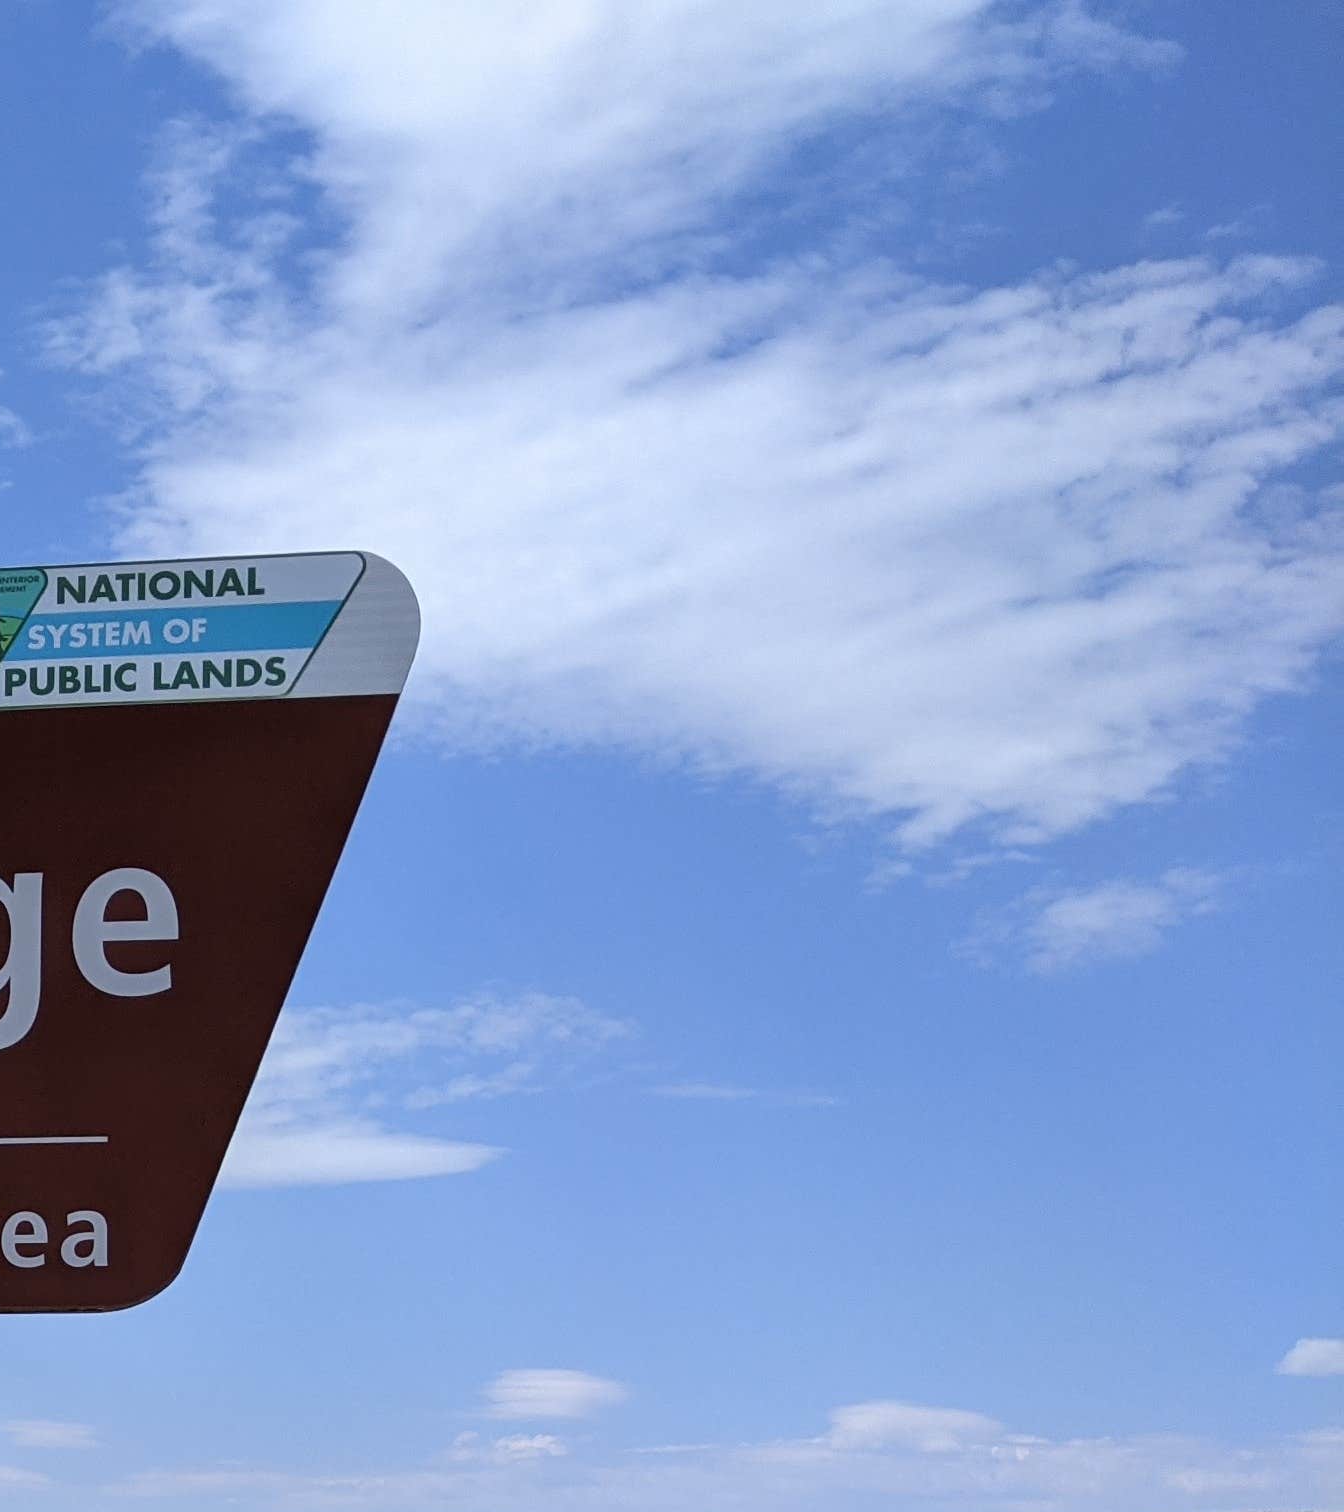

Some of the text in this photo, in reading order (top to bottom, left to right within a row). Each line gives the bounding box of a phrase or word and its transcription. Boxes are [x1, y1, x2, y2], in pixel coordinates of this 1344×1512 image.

[0, 575, 40, 585] INTERIOR
[56, 566, 266, 605] NATIONAL
[28, 617, 208, 650] SYSTEM OF
[4, 656, 287, 697] PUBLIC LANDS
